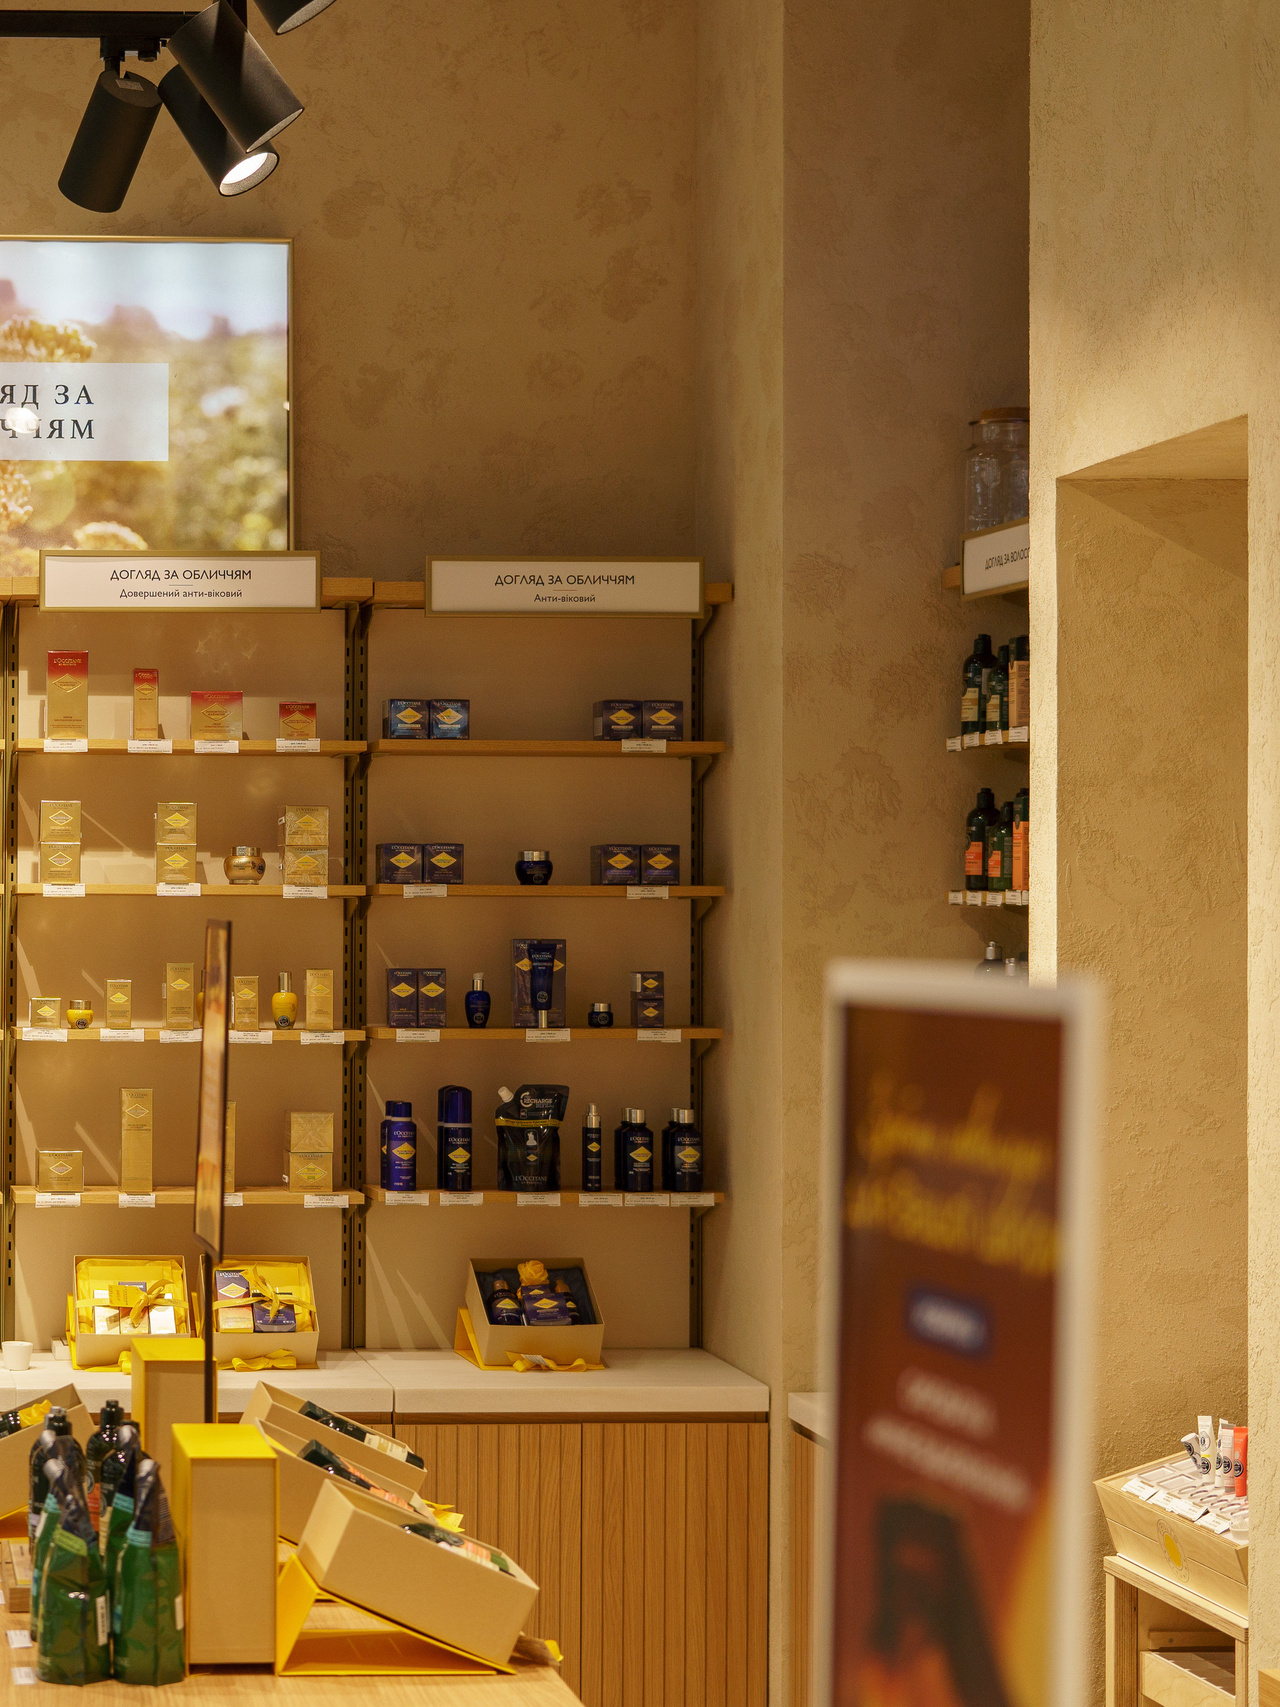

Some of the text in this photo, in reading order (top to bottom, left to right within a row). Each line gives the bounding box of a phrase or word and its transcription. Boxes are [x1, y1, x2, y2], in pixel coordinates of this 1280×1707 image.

[54, 384, 95, 405] ЗА
[109, 569, 252, 582] ДОГЛЯД ЗА ОБЛИЧЧЯМ
[494, 574, 635, 587] ДОГЛЯД ЗА ОБЛИЧЧЯМ
[119, 588, 243, 600] Довершений анти-віковий
[533, 593, 596, 603] Анти-віковий
